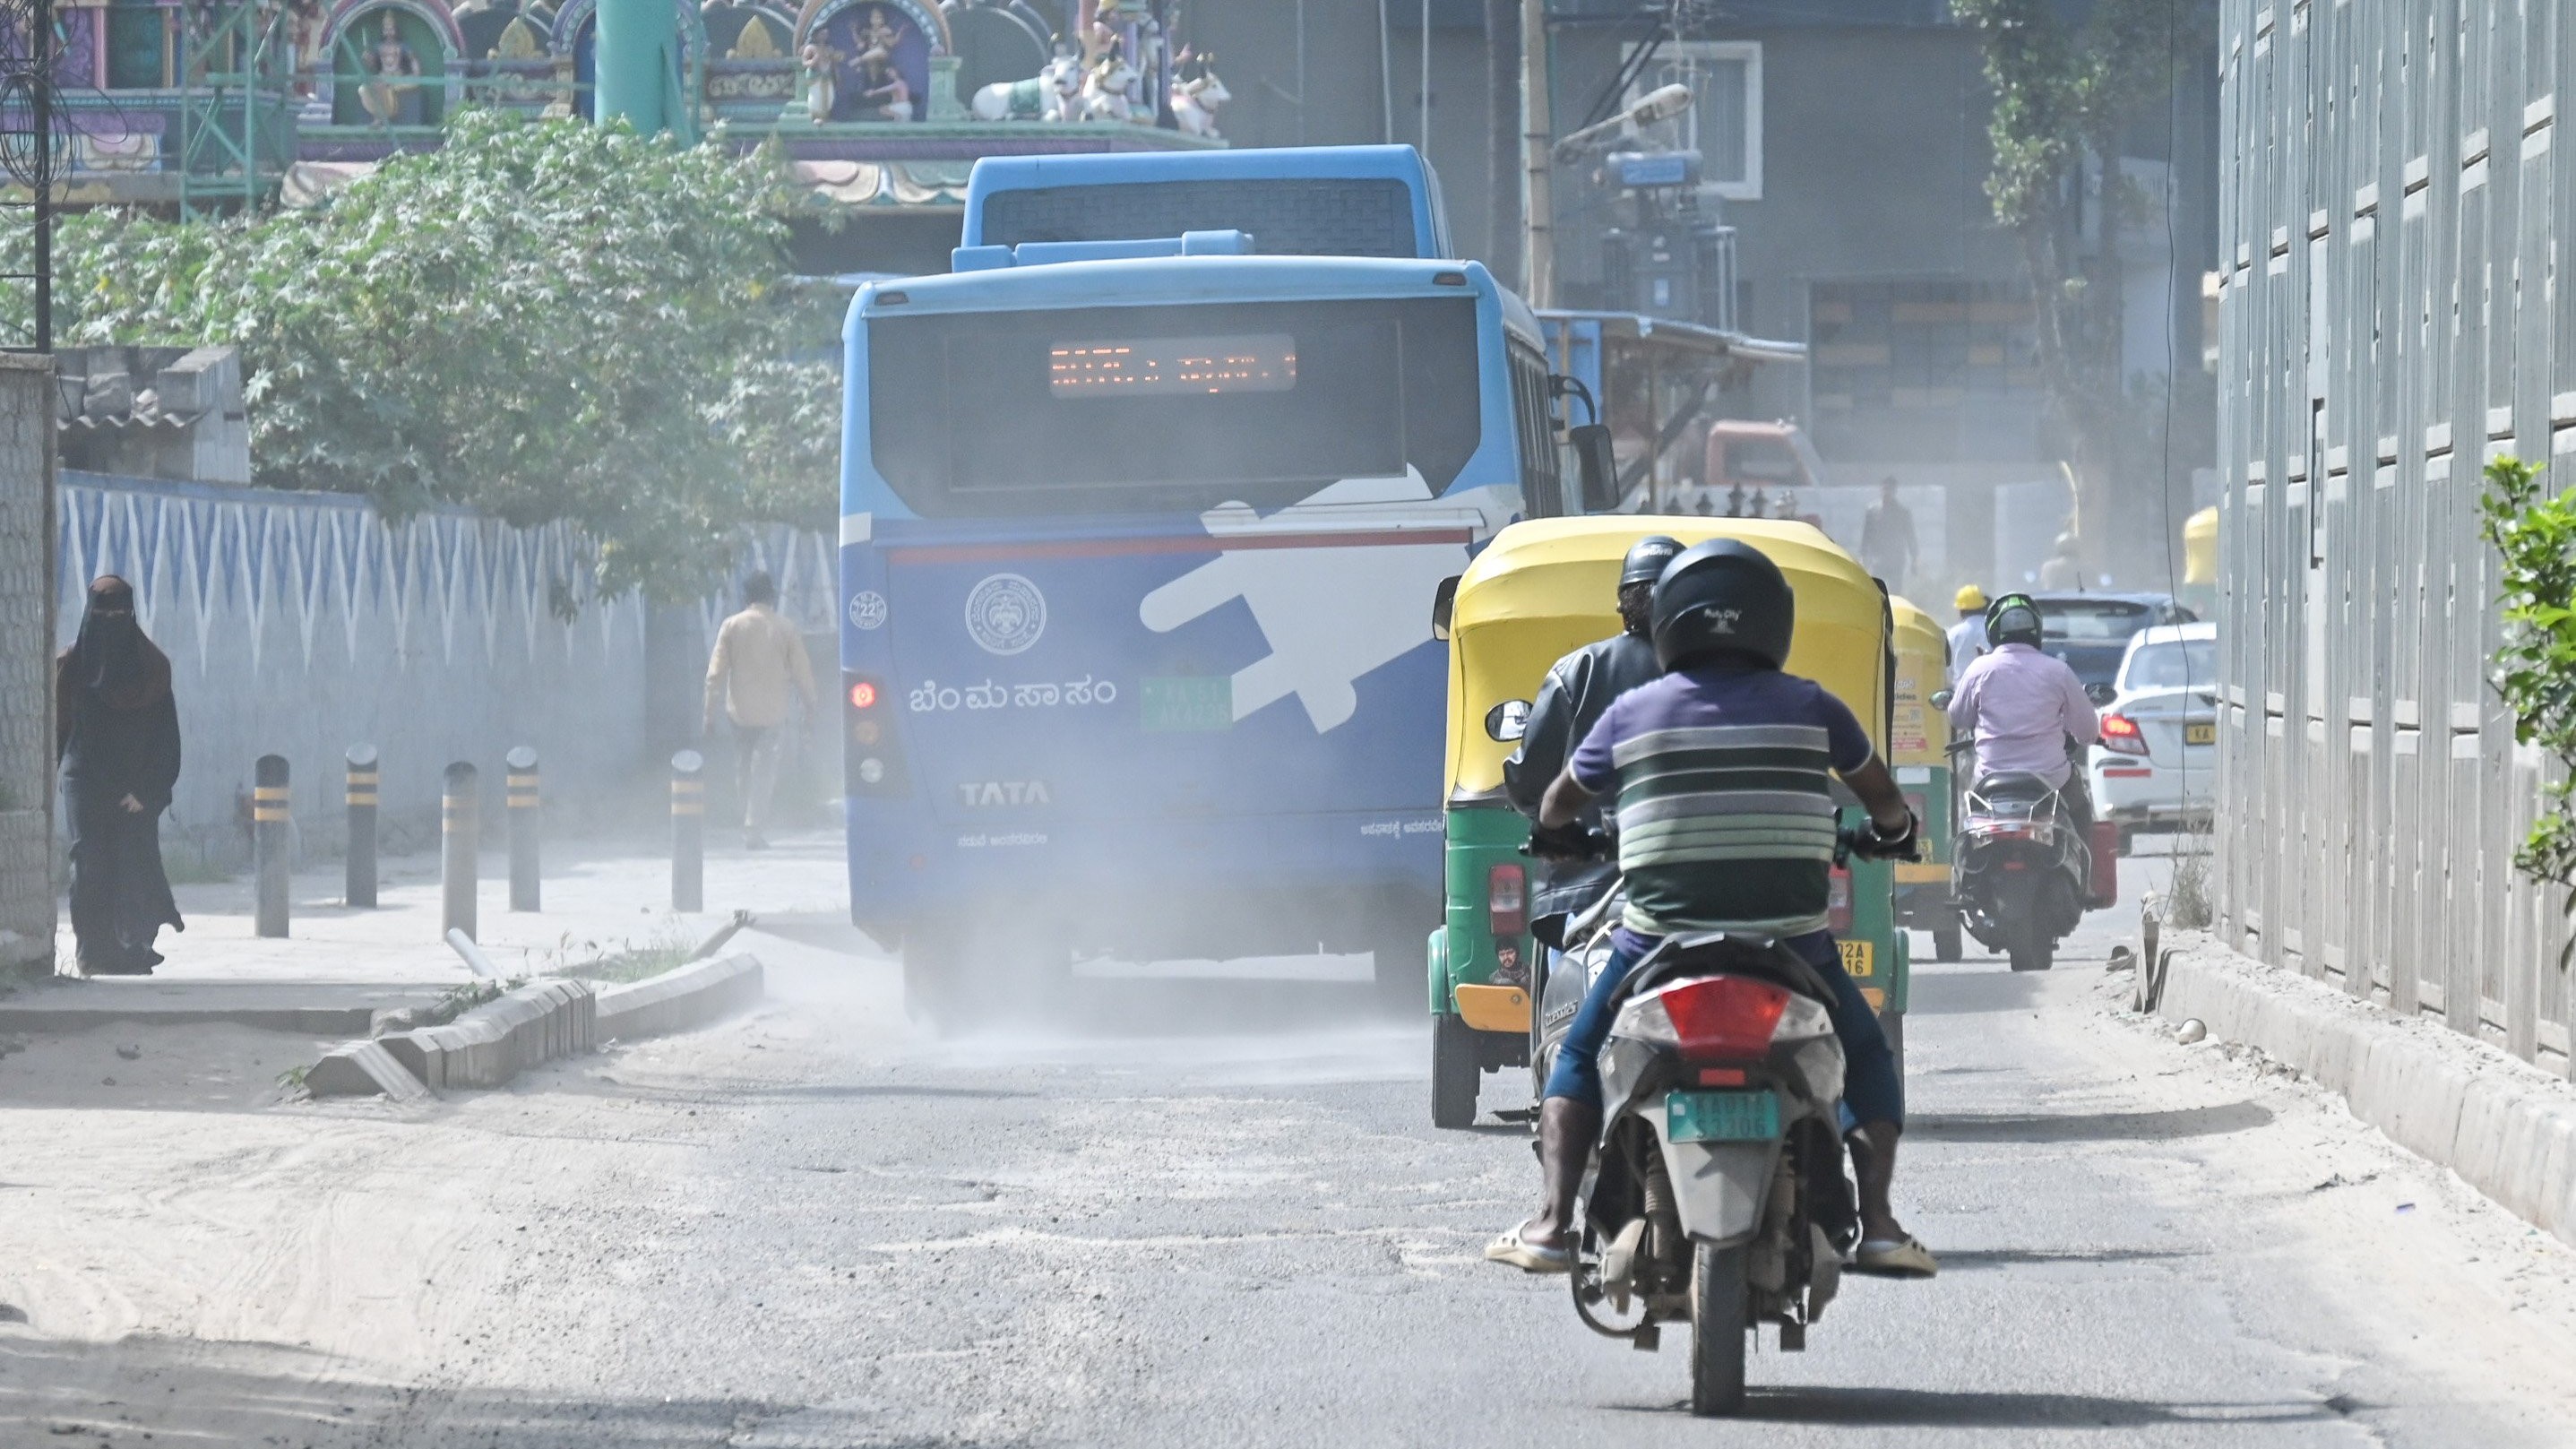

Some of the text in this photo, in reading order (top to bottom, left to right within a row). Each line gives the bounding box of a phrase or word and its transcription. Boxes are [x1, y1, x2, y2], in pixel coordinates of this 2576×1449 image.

[860, 603, 875, 617] 22
[959, 781, 1049, 806] TATA
[1847, 960, 1864, 975] 16
